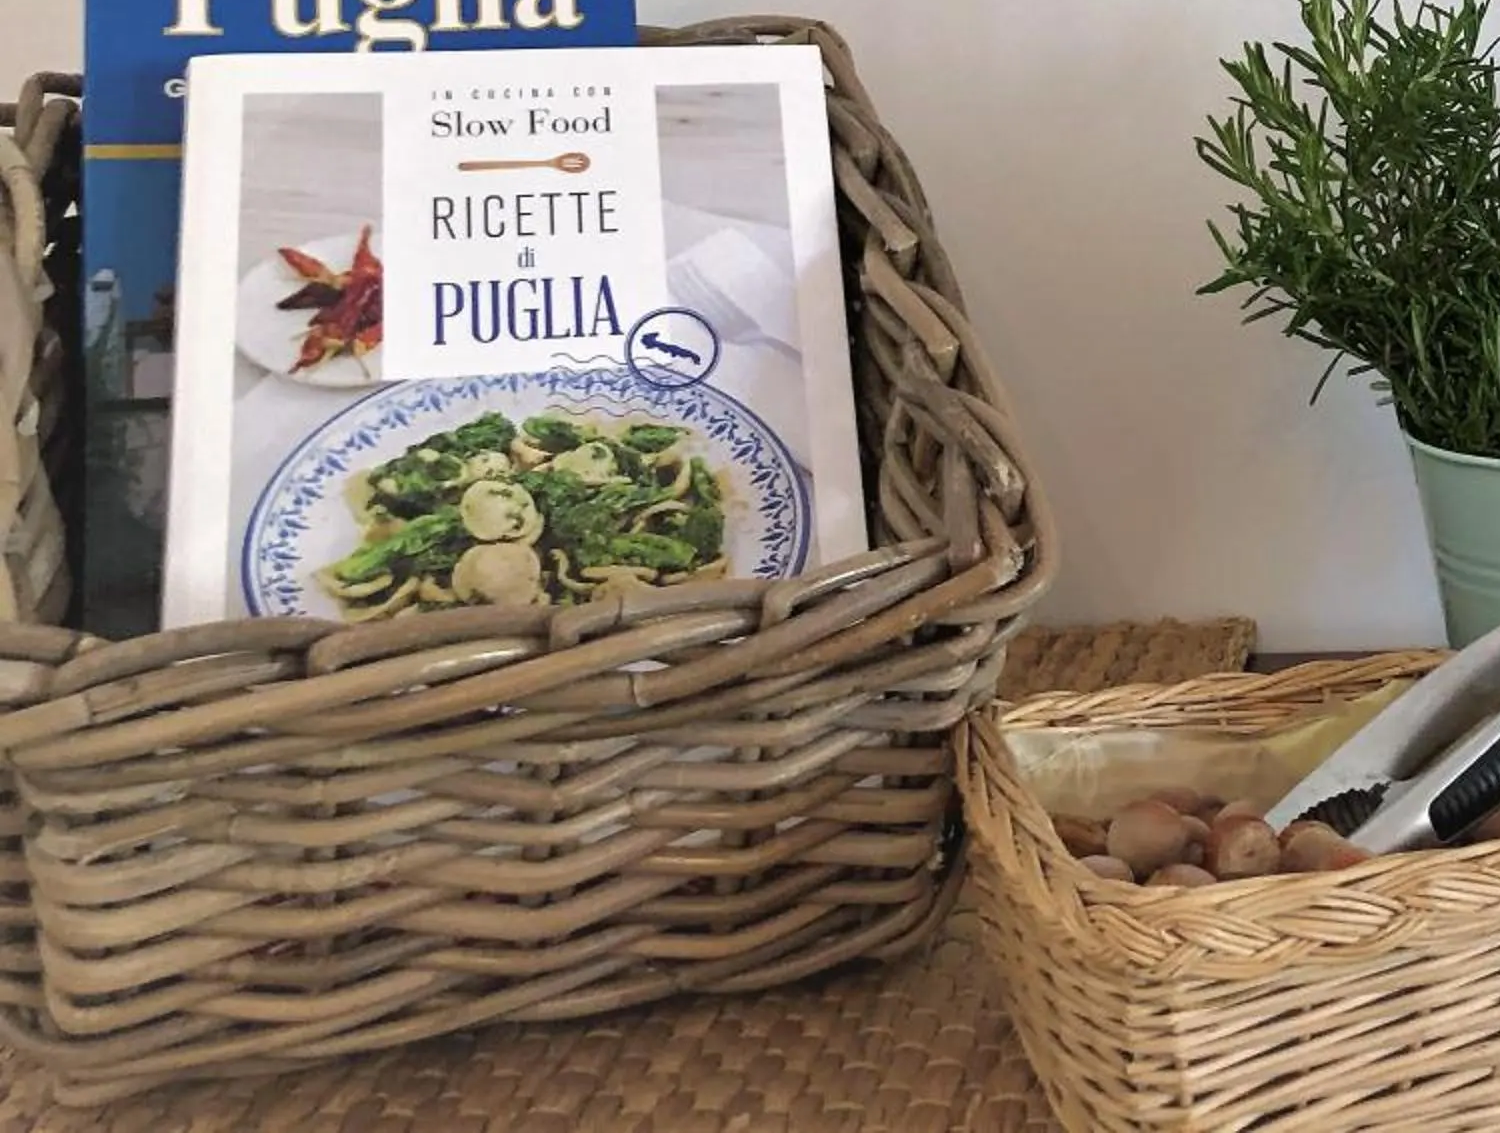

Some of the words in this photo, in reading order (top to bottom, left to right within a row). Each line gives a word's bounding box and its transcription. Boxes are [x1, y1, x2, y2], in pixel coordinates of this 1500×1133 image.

[431, 90, 453, 100] IN
[471, 87, 554, 100] CUCINA
[572, 86, 612, 97] CON
[431, 110, 514, 138] Slow
[527, 106, 612, 136] Food
[432, 190, 619, 240] RICETTE
[517, 246, 536, 268] di
[432, 274, 625, 346] PUGLIA
